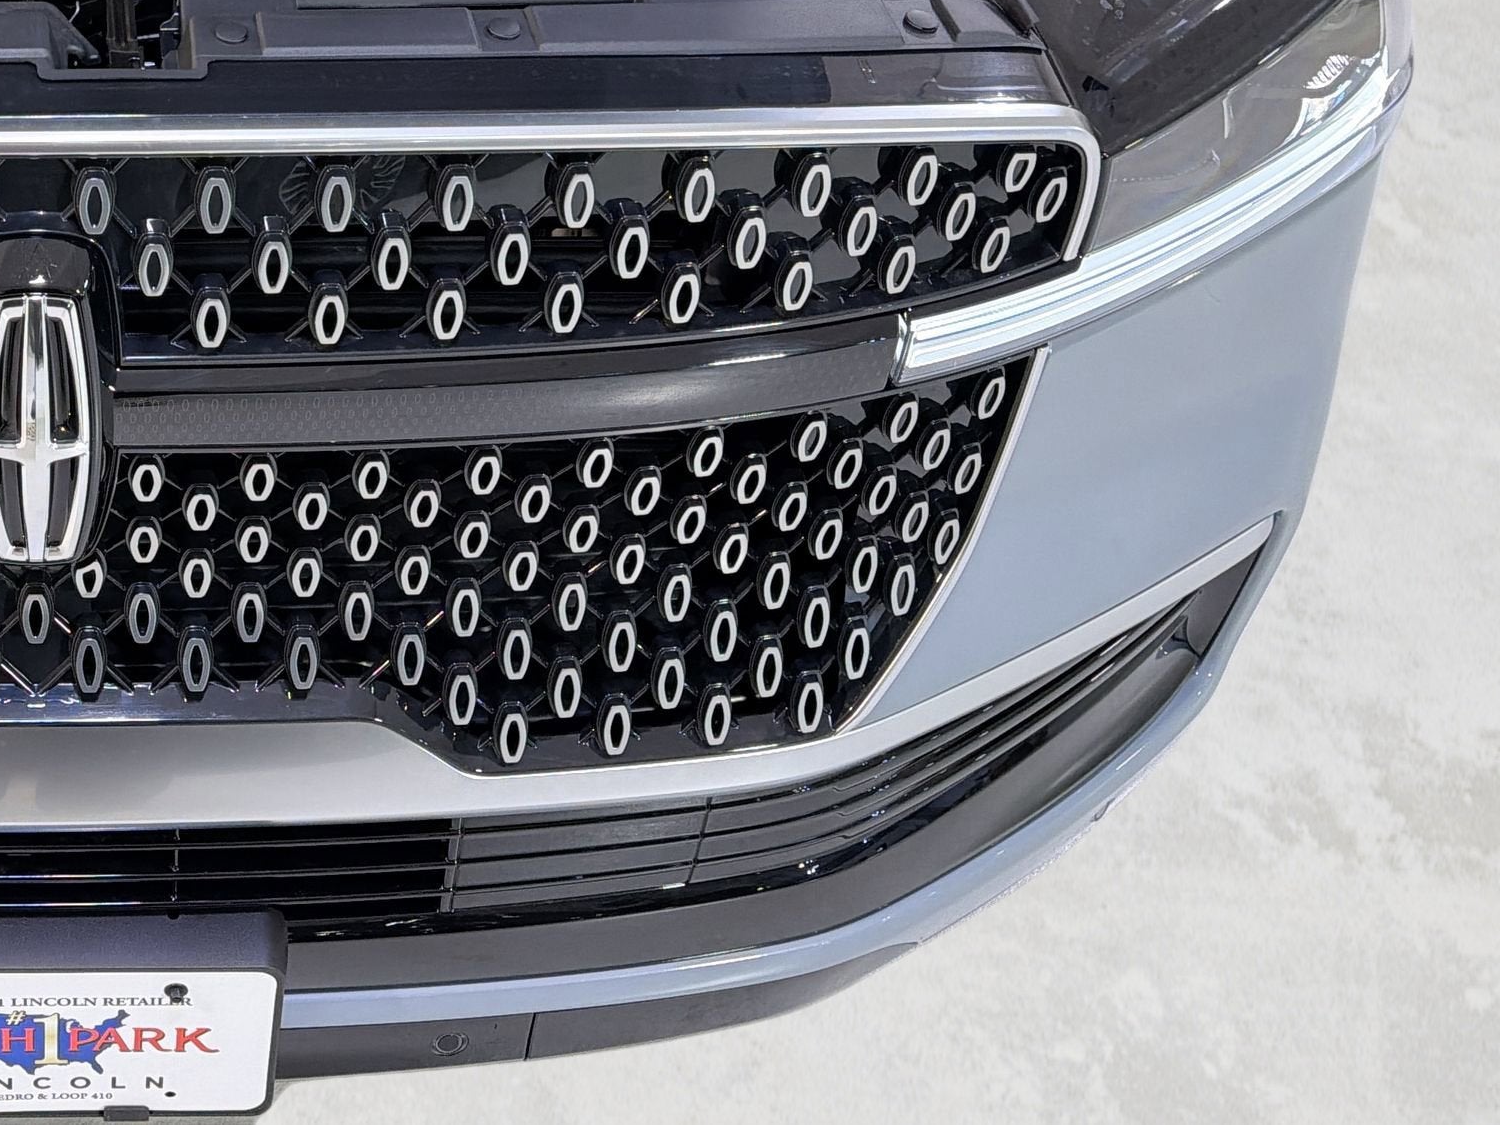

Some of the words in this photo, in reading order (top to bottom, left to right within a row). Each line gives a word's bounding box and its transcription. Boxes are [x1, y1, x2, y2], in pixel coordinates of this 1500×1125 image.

[11, 997, 97, 1007] LINCOLN
[68, 1027, 220, 1053] PARK
[51, 1092, 88, 1100] LOOP
[91, 1092, 113, 1100] 410
